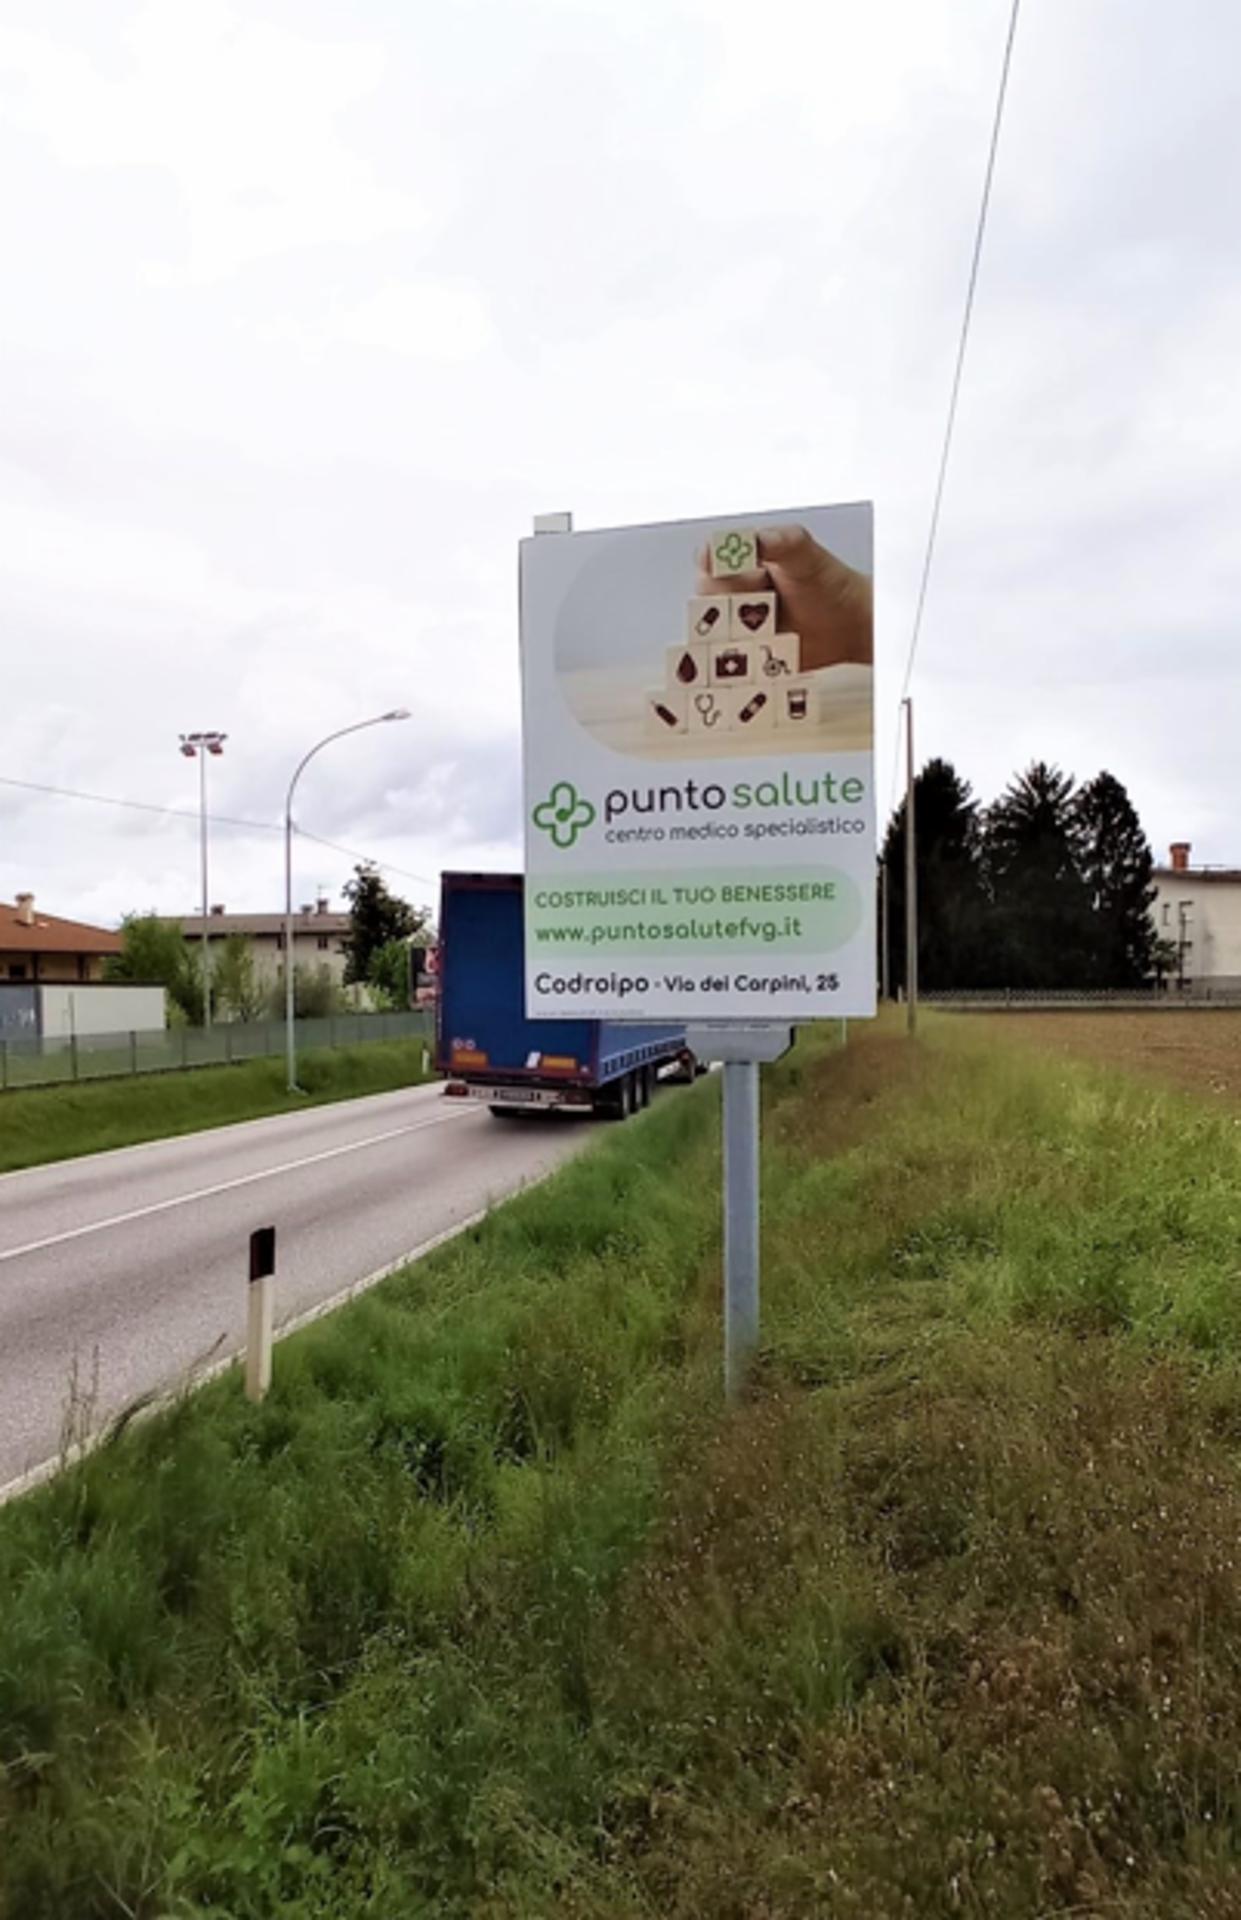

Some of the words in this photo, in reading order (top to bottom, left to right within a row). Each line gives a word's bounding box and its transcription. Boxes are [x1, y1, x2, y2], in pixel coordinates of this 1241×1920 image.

[605, 779, 726, 823] punto
[732, 771, 864, 809] salute
[605, 826, 665, 843] centro
[670, 821, 739, 840] medico
[744, 818, 865, 840] specialistico
[535, 888, 646, 908] COSTRUISCI
[651, 888, 668, 905] IL
[673, 887, 717, 904] TUO
[721, 882, 836, 902] BENESSERE
[535, 918, 802, 943] www.puntosalutefvg.it
[535, 972, 649, 998] Codroipo
[663, 976, 695, 992] Via
[734, 975, 812, 994] Carpini,
